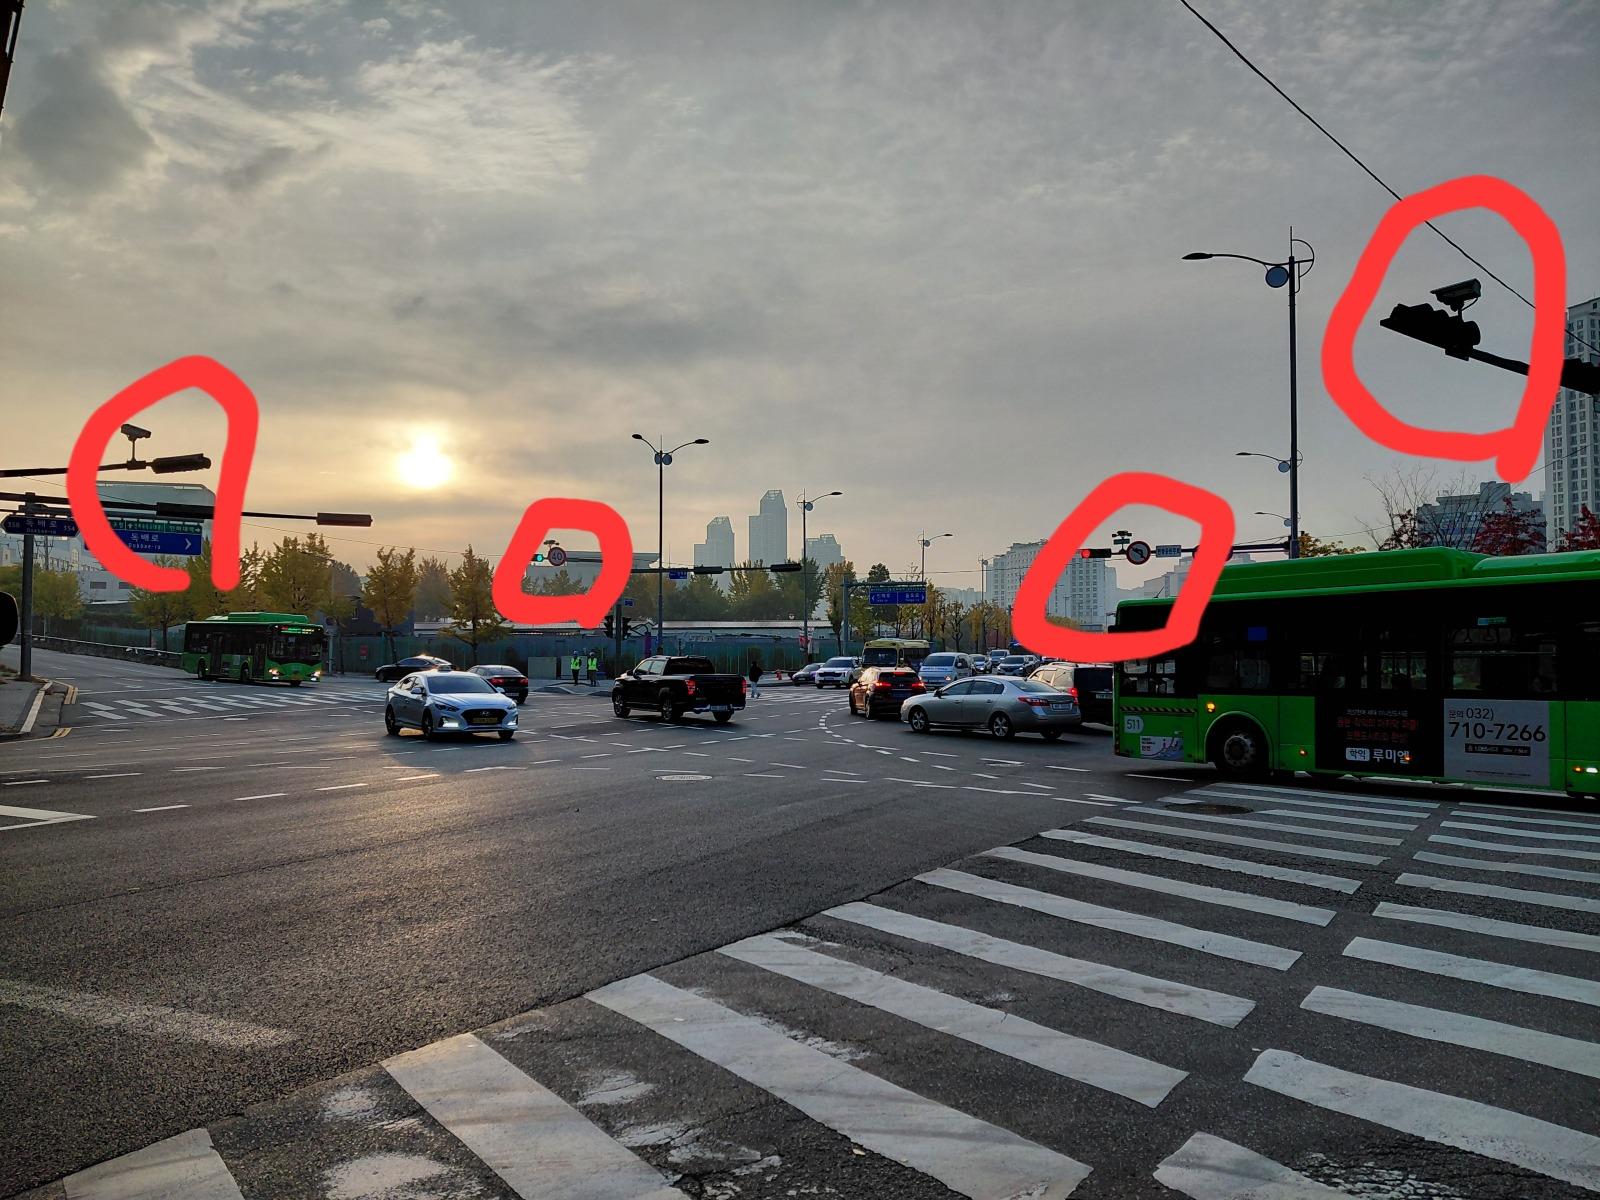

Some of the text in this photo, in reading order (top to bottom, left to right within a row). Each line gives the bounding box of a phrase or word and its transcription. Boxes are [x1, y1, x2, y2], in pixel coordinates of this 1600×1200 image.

[25, 519, 57, 528] 독배로
[130, 532, 160, 542] 독배로
[552, 551, 563, 560] 40
[1448, 707, 1494, 720] 문의 032)
[1126, 718, 1140, 729] 511
[1448, 721, 1546, 742] 710-7266
[1349, 748, 1410, 764] 학익 루미엘
